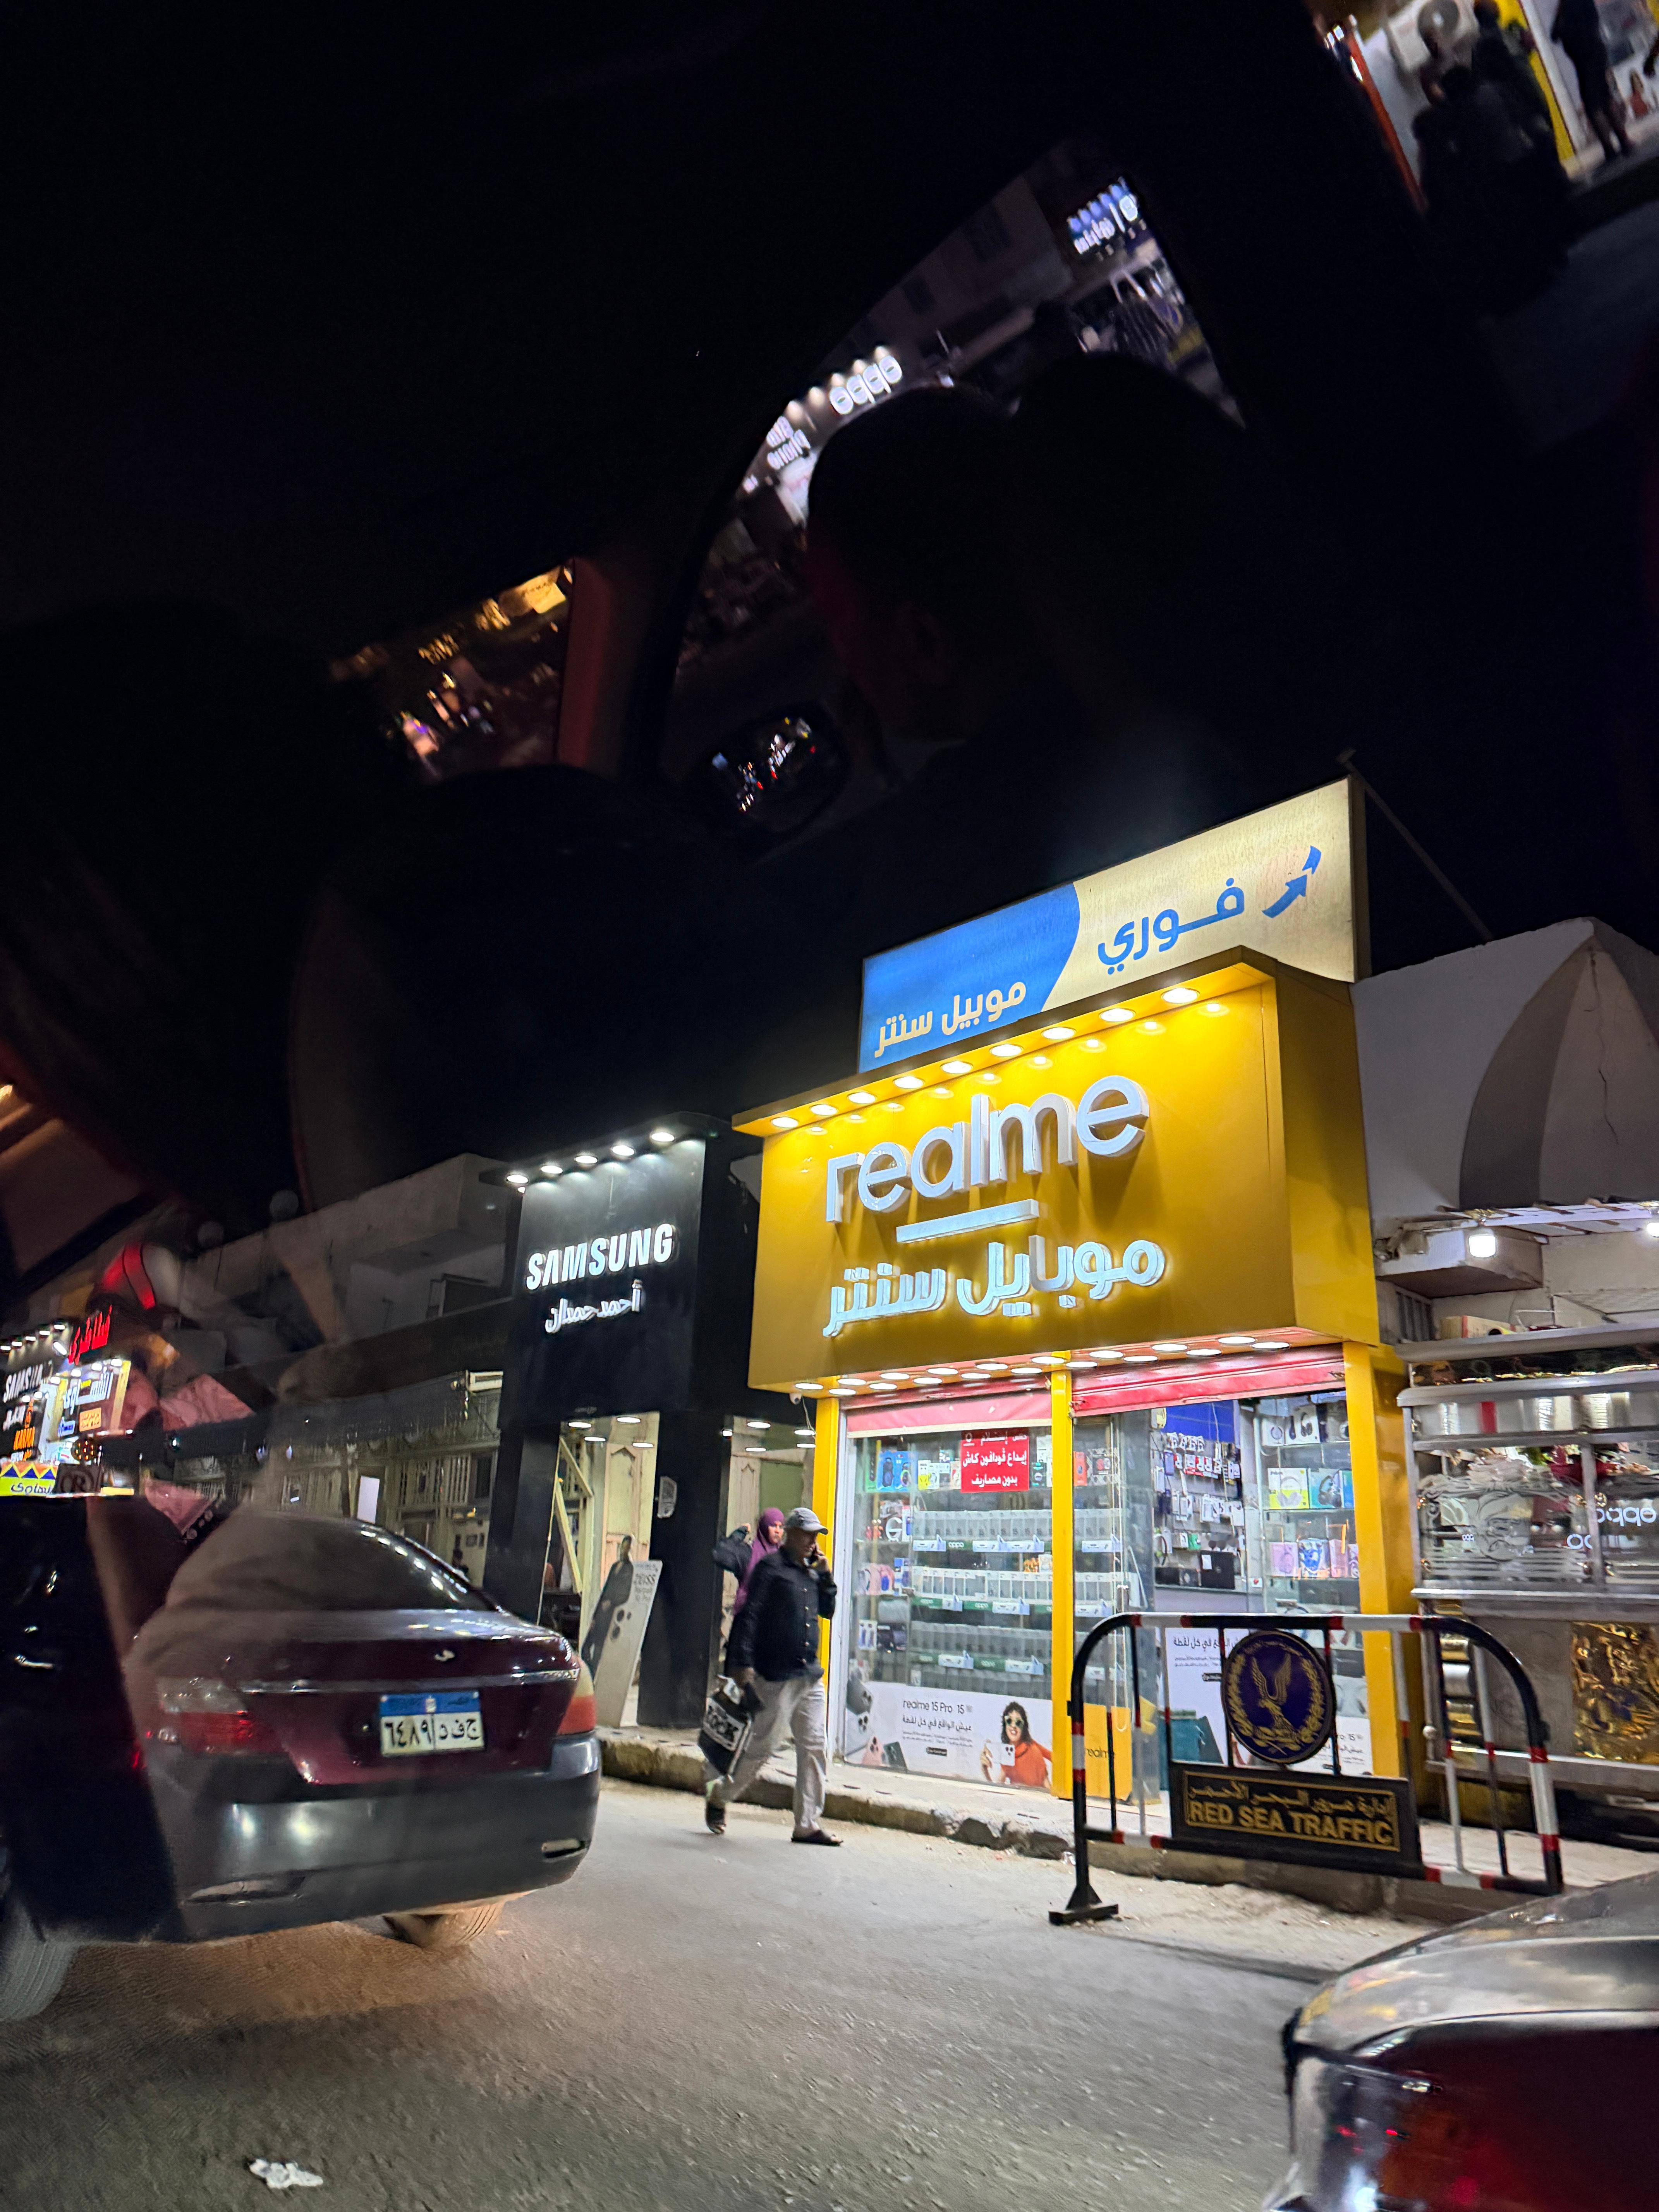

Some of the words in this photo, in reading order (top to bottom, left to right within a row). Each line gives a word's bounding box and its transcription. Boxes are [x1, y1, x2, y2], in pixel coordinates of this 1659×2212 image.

[1097, 878, 1245, 976] فوري
[941, 981, 1027, 1036] موبيل
[873, 1010, 934, 1059] سنتر
[825, 1075, 1150, 1224] realme
[526, 1223, 674, 1291] SAMSUNG
[956, 1234, 1166, 1317] موبايل
[823, 1262, 947, 1338] سنتر
[962, 1451, 979, 1467] كاش
[971, 1474, 1001, 1488] مصاريف
[1002, 1475, 1018, 1487] بدون
[1007, 1450, 1027, 1467] إيداع
[940, 1702, 953, 1713] Pro
[1189, 1801, 1234, 1824] RED
[1238, 1805, 1286, 1832] SEA
[1288, 1810, 1393, 1845] TRAFFIC
